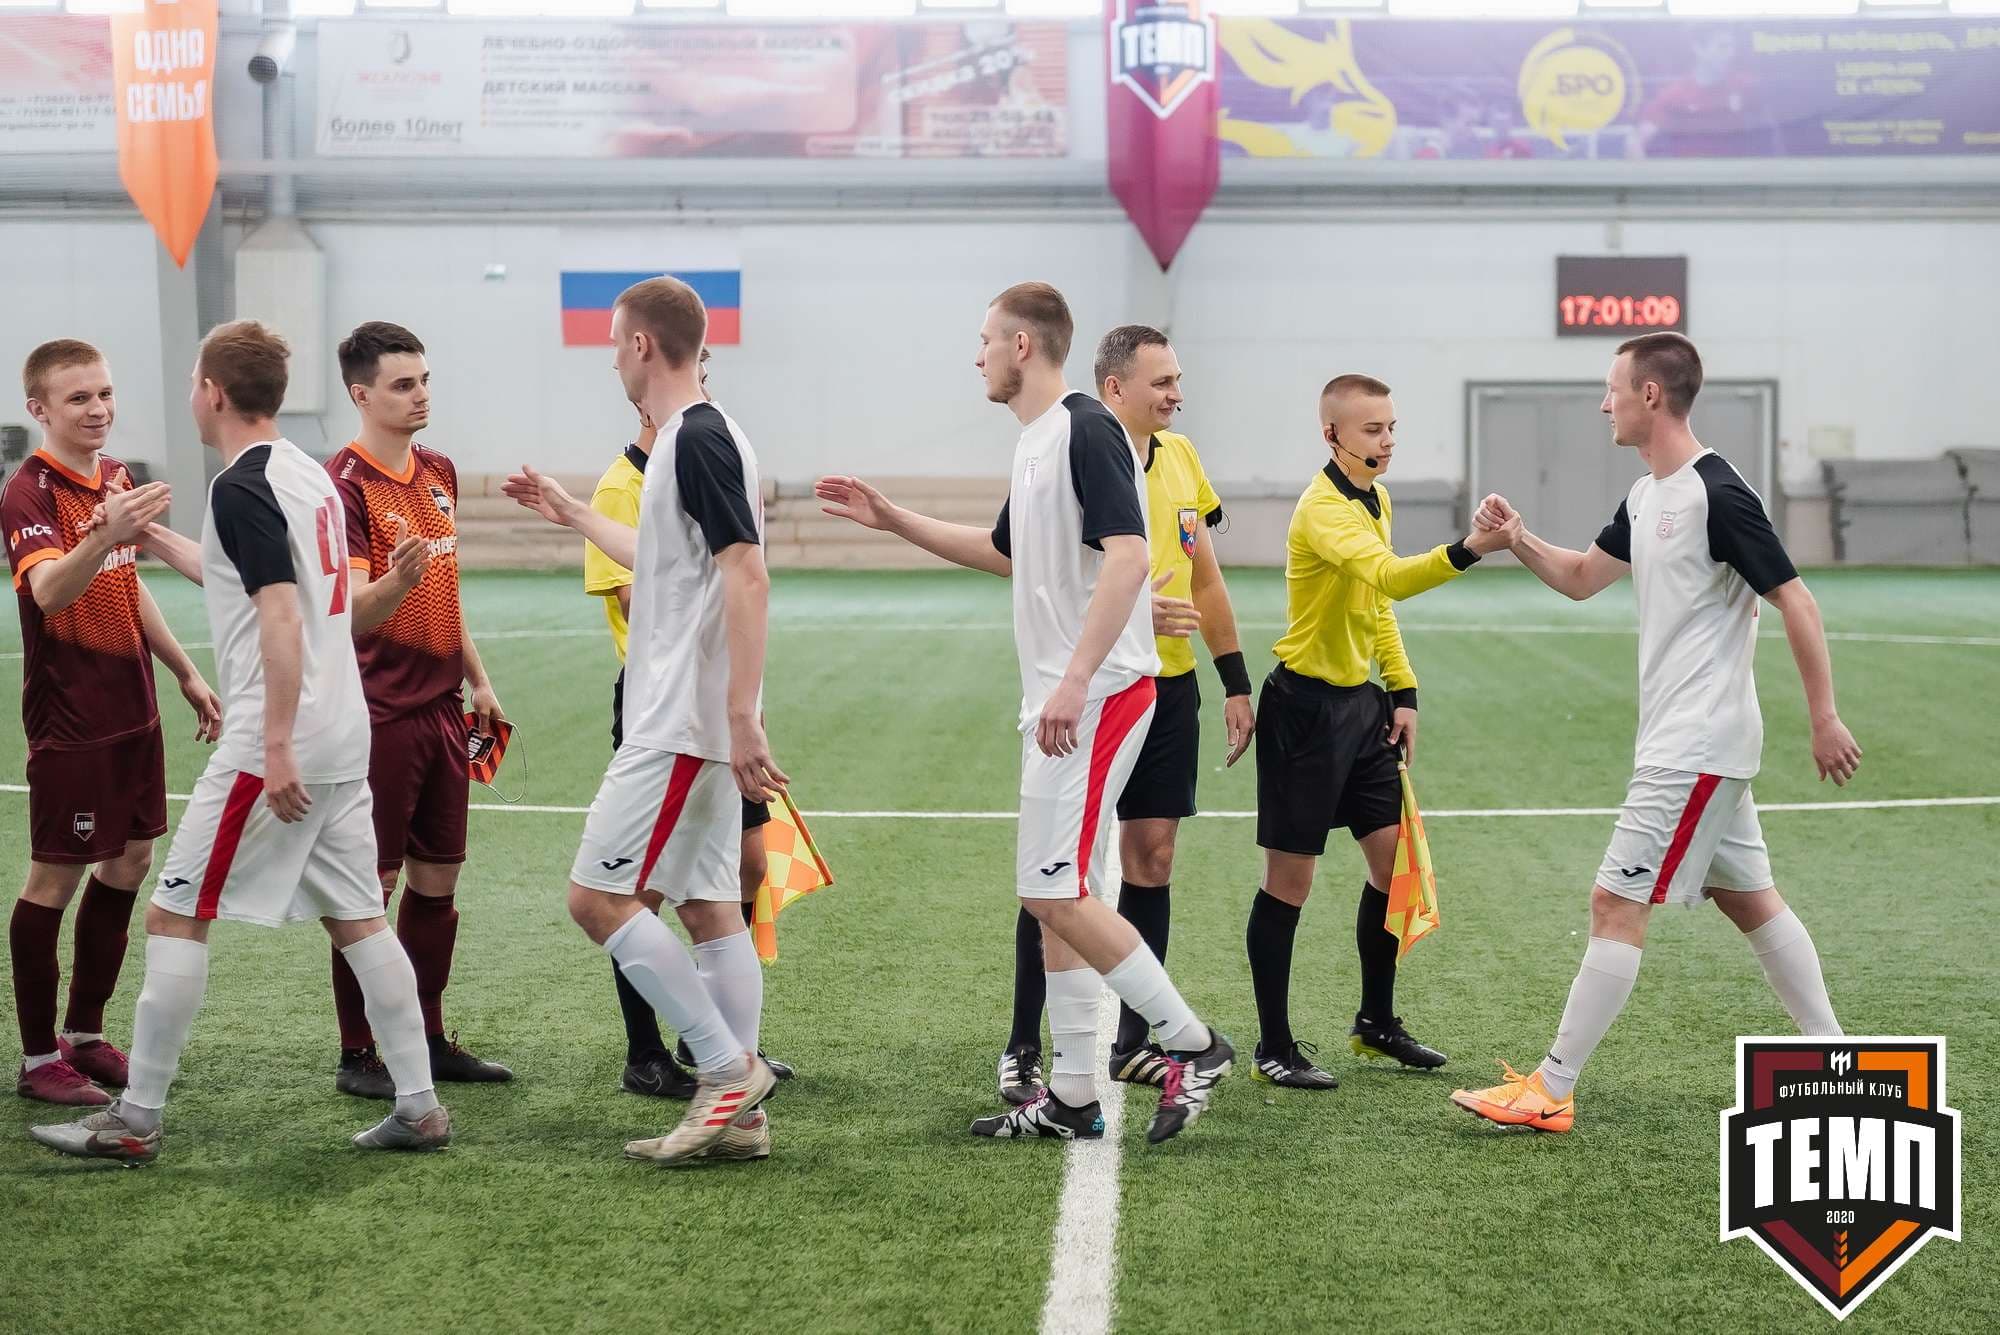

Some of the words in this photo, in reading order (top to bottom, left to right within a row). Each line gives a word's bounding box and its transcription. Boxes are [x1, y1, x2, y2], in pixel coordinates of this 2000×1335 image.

[134, 28, 205, 75] ОДНА
[1120, 22, 1206, 68] ТЕМП
[127, 79, 207, 123] СЕМЬЯ
[330, 117, 397, 137] более
[1560, 296, 1681, 326] 17:01:09
[21, 523, 53, 540] ПСБ
[315, 495, 348, 616] 4
